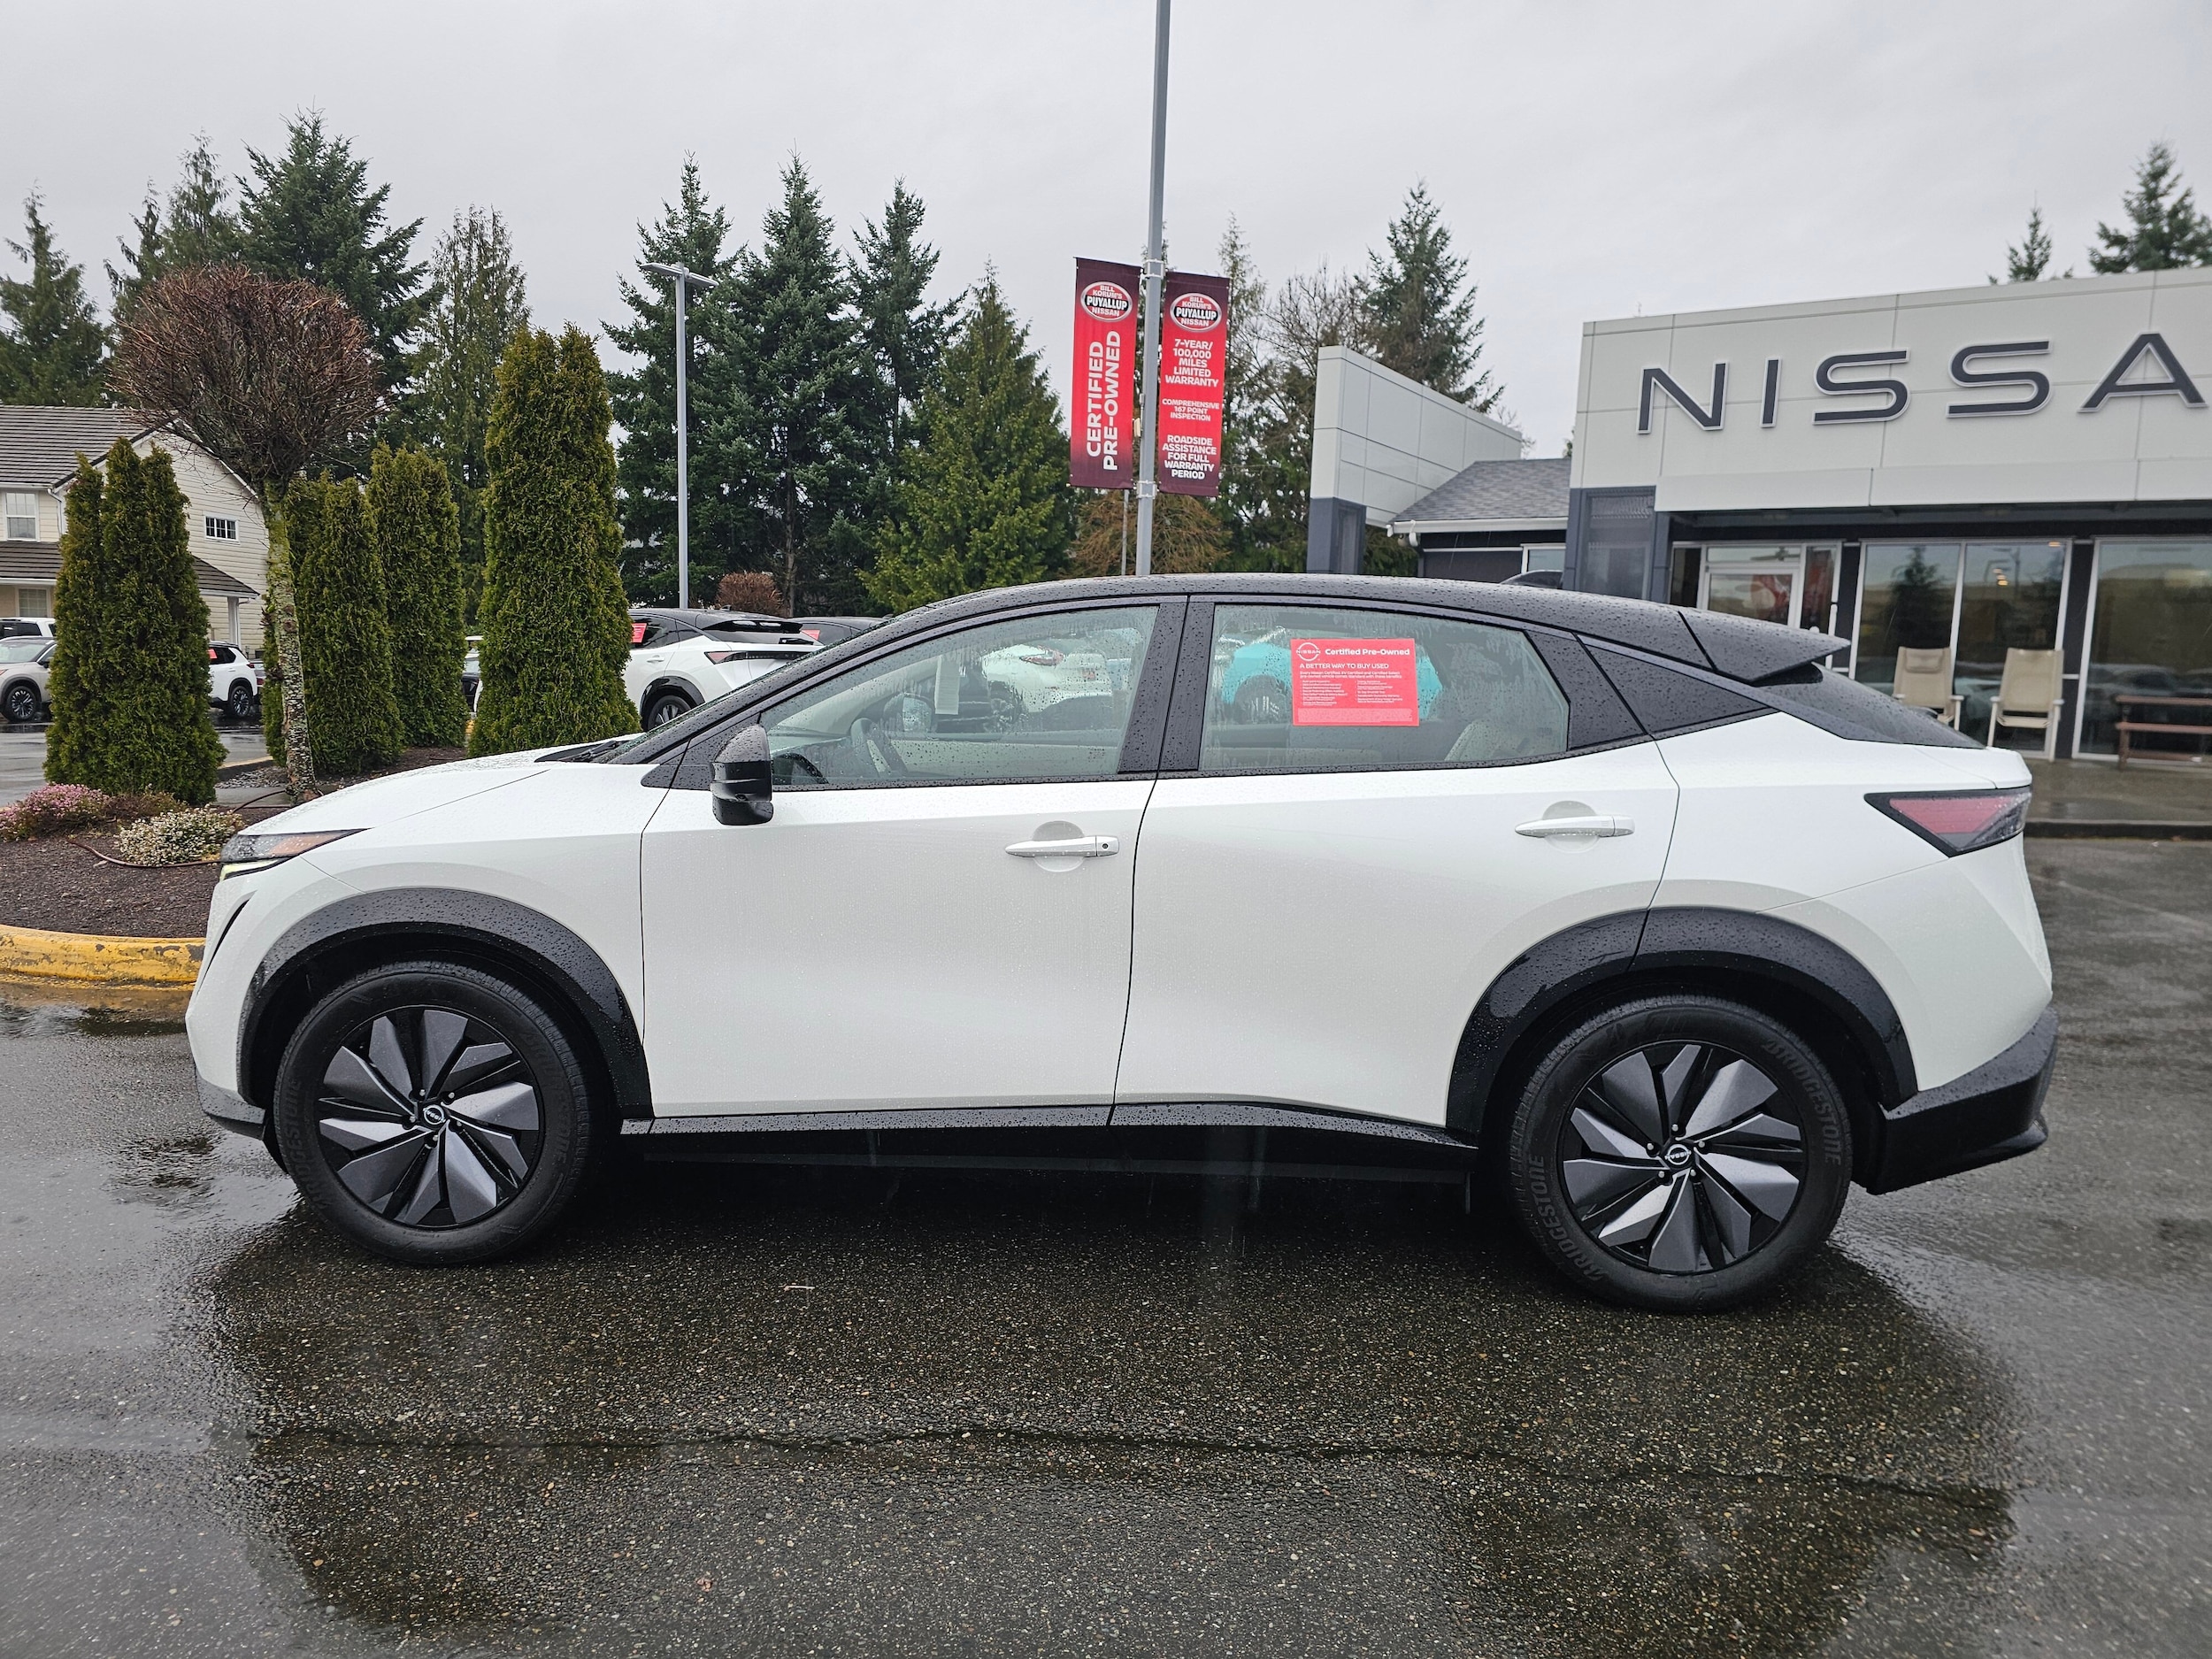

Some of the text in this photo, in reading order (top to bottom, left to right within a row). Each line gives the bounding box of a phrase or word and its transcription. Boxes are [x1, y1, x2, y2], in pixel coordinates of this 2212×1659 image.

[1087, 296, 1127, 310] PUYALLUP
[1092, 306, 1120, 317] NISSAN
[1176, 307, 1217, 320] PUYALLUP
[1180, 318, 1210, 326] NISSAN
[1174, 338, 1213, 351] 7-YEAR/
[1172, 348, 1211, 359] 100,000
[1179, 357, 1208, 368] MILES
[1173, 366, 1211, 378] LIMITED
[1164, 374, 1219, 388] WARRANTY
[1637, 331, 2209, 434] NISSA
[1087, 341, 1103, 457] CERTIFIED
[1103, 330, 1121, 471] PRE-OWNED
[1162, 398, 1220, 410] COMPREHENSIVE
[1170, 412, 1211, 421] INSPECTION
[1167, 434, 1213, 446] ROADSIDE
[1162, 443, 1217, 455] ASSISTANCE
[1167, 451, 1210, 463] FOR FULL
[1164, 459, 1215, 472] WARRANTY
[1171, 469, 1205, 480] PERIOD
[1528, 1154, 1609, 1282] BRIDGESTONE
